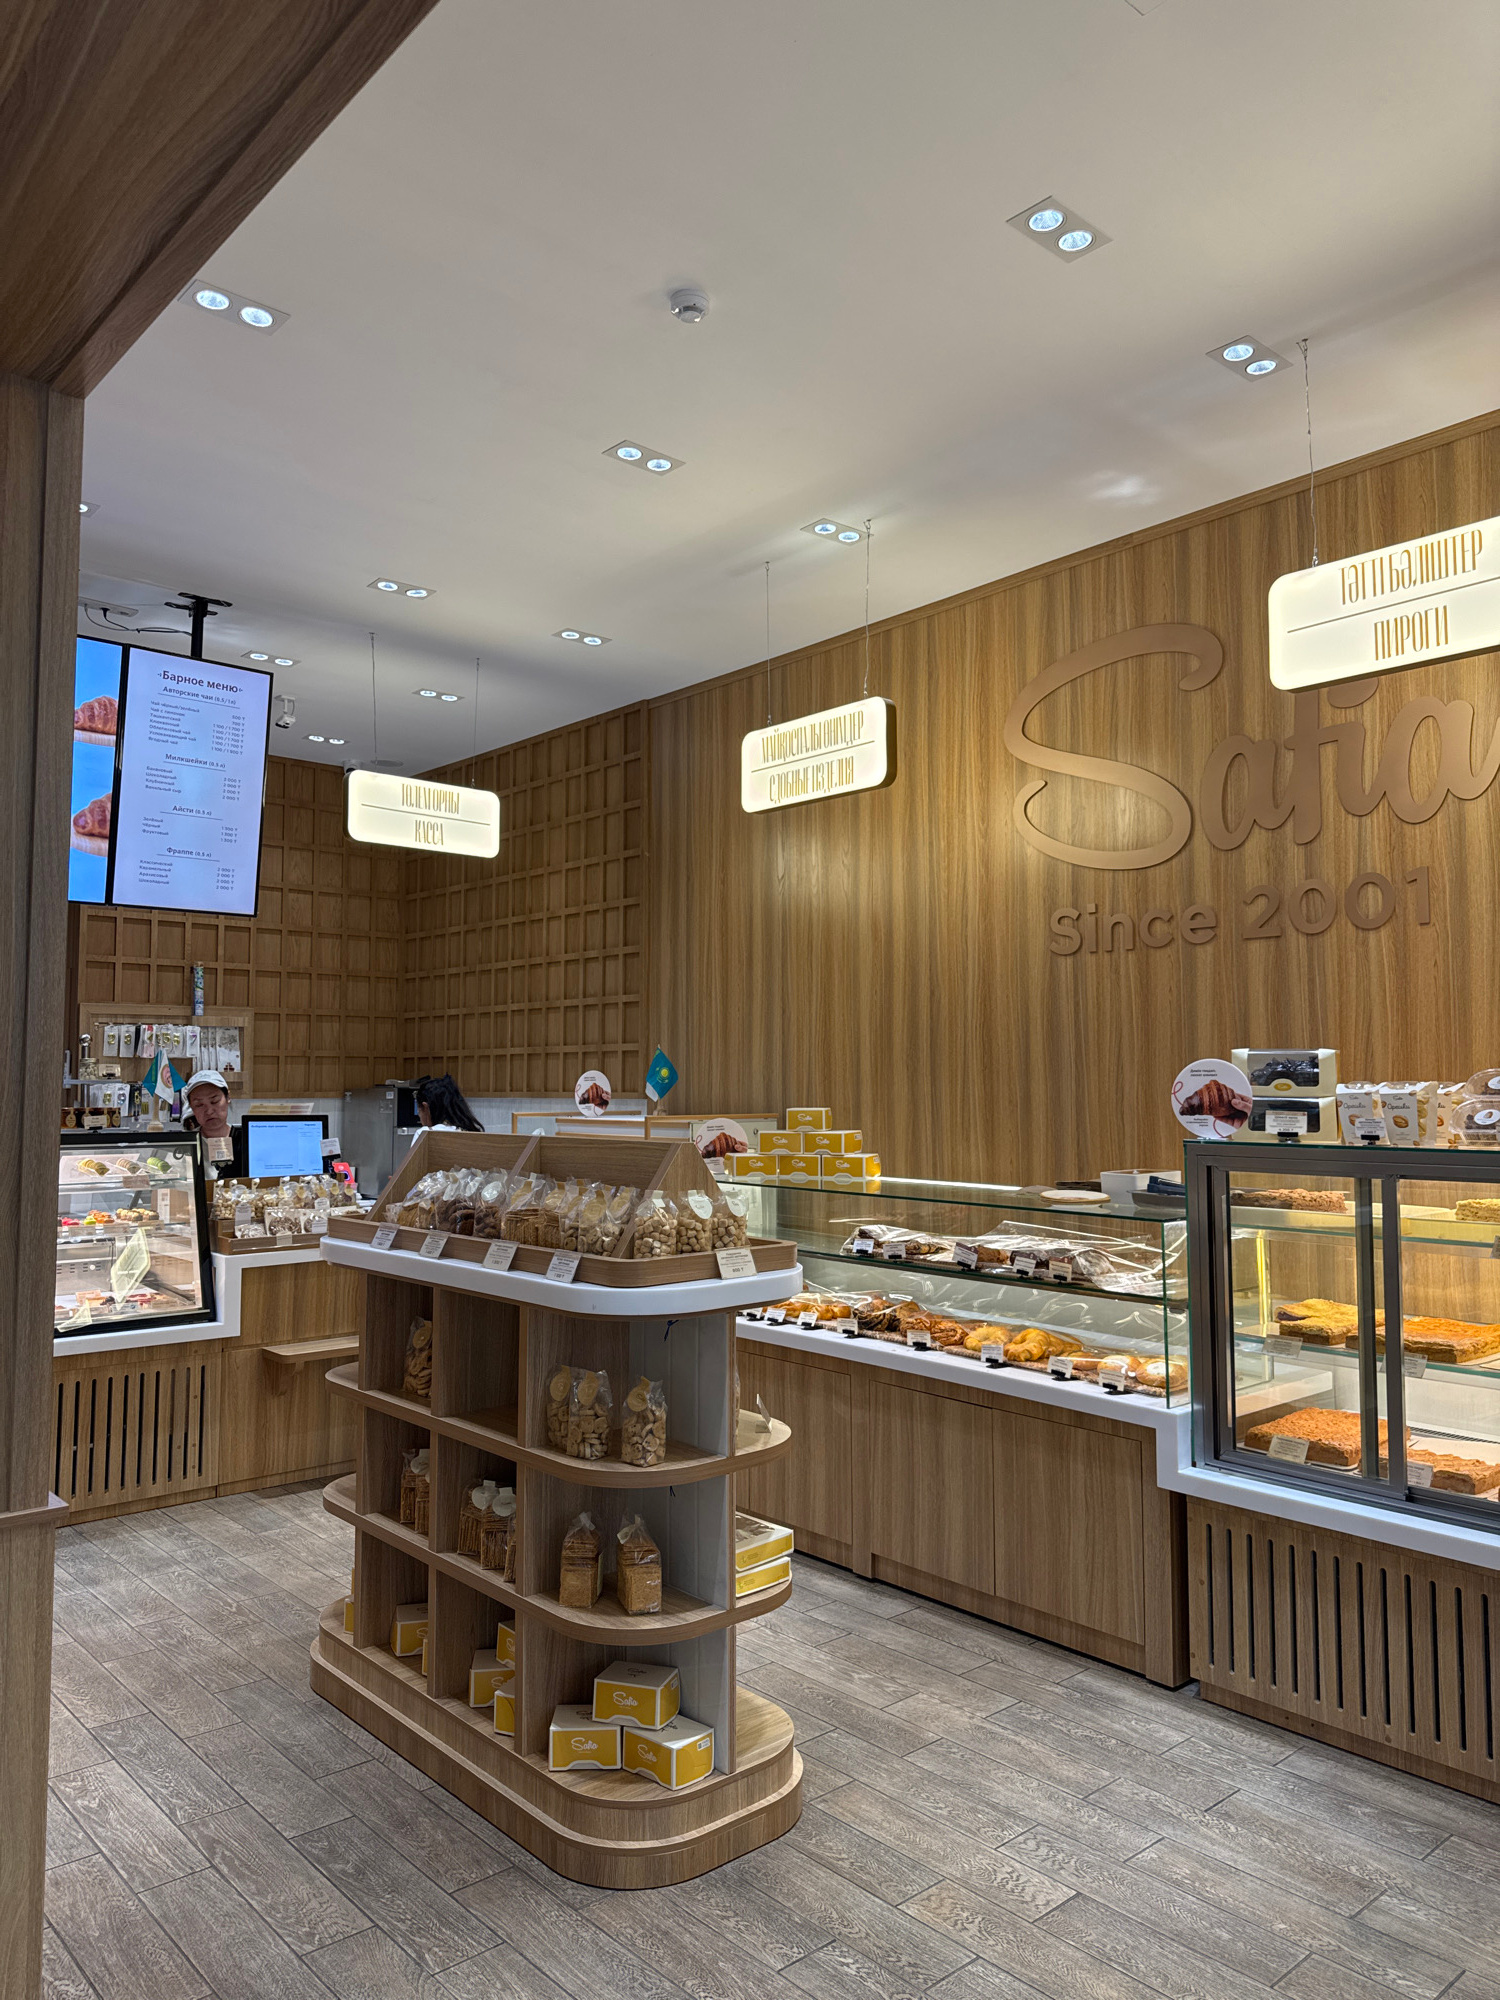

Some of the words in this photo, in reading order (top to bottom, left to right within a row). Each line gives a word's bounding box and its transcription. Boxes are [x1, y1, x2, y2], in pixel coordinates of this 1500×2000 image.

[1338, 556, 1384, 605] ТӘТТІ
[1388, 530, 1483, 593] БӘЛІШТЕР
[1374, 605, 1449, 661] ПИРОГИ
[162, 670, 204, 686] Барное
[207, 681, 238, 693] меню
[163, 686, 200, 698] Авторские
[165, 754, 207, 765] Милкшейки
[770, 766, 810, 804] СДОБНЫЕ
[812, 756, 854, 793] ИЗДЕЛИЯ
[172, 805, 194, 814] Айсти
[414, 820, 444, 846] КАССА
[167, 847, 194, 856] Фраппе
[1243, 865, 1432, 939] 2001
[571, 1737, 598, 1751] Safia
